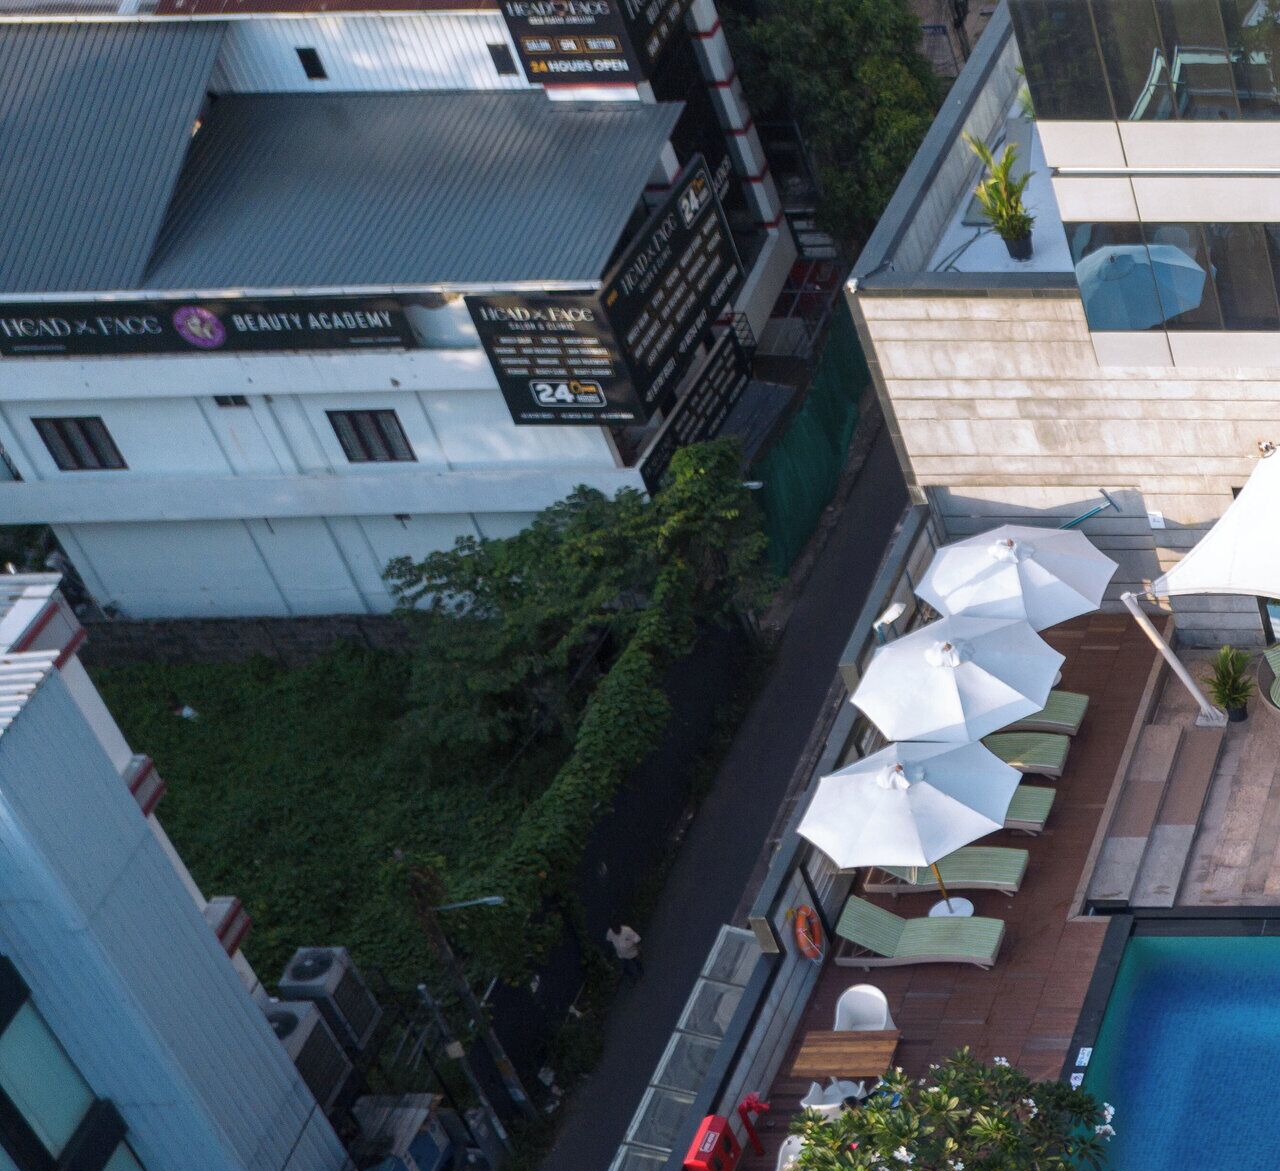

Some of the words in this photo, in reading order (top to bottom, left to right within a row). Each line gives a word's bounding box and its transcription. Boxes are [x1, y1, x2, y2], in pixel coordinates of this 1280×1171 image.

[547, 60, 593, 73] HOURS
[593, 59, 629, 72] OPEN
[231, 312, 301, 332] BEAUTY
[308, 311, 393, 331] ACADEMY
[534, 383, 575, 403] 24
